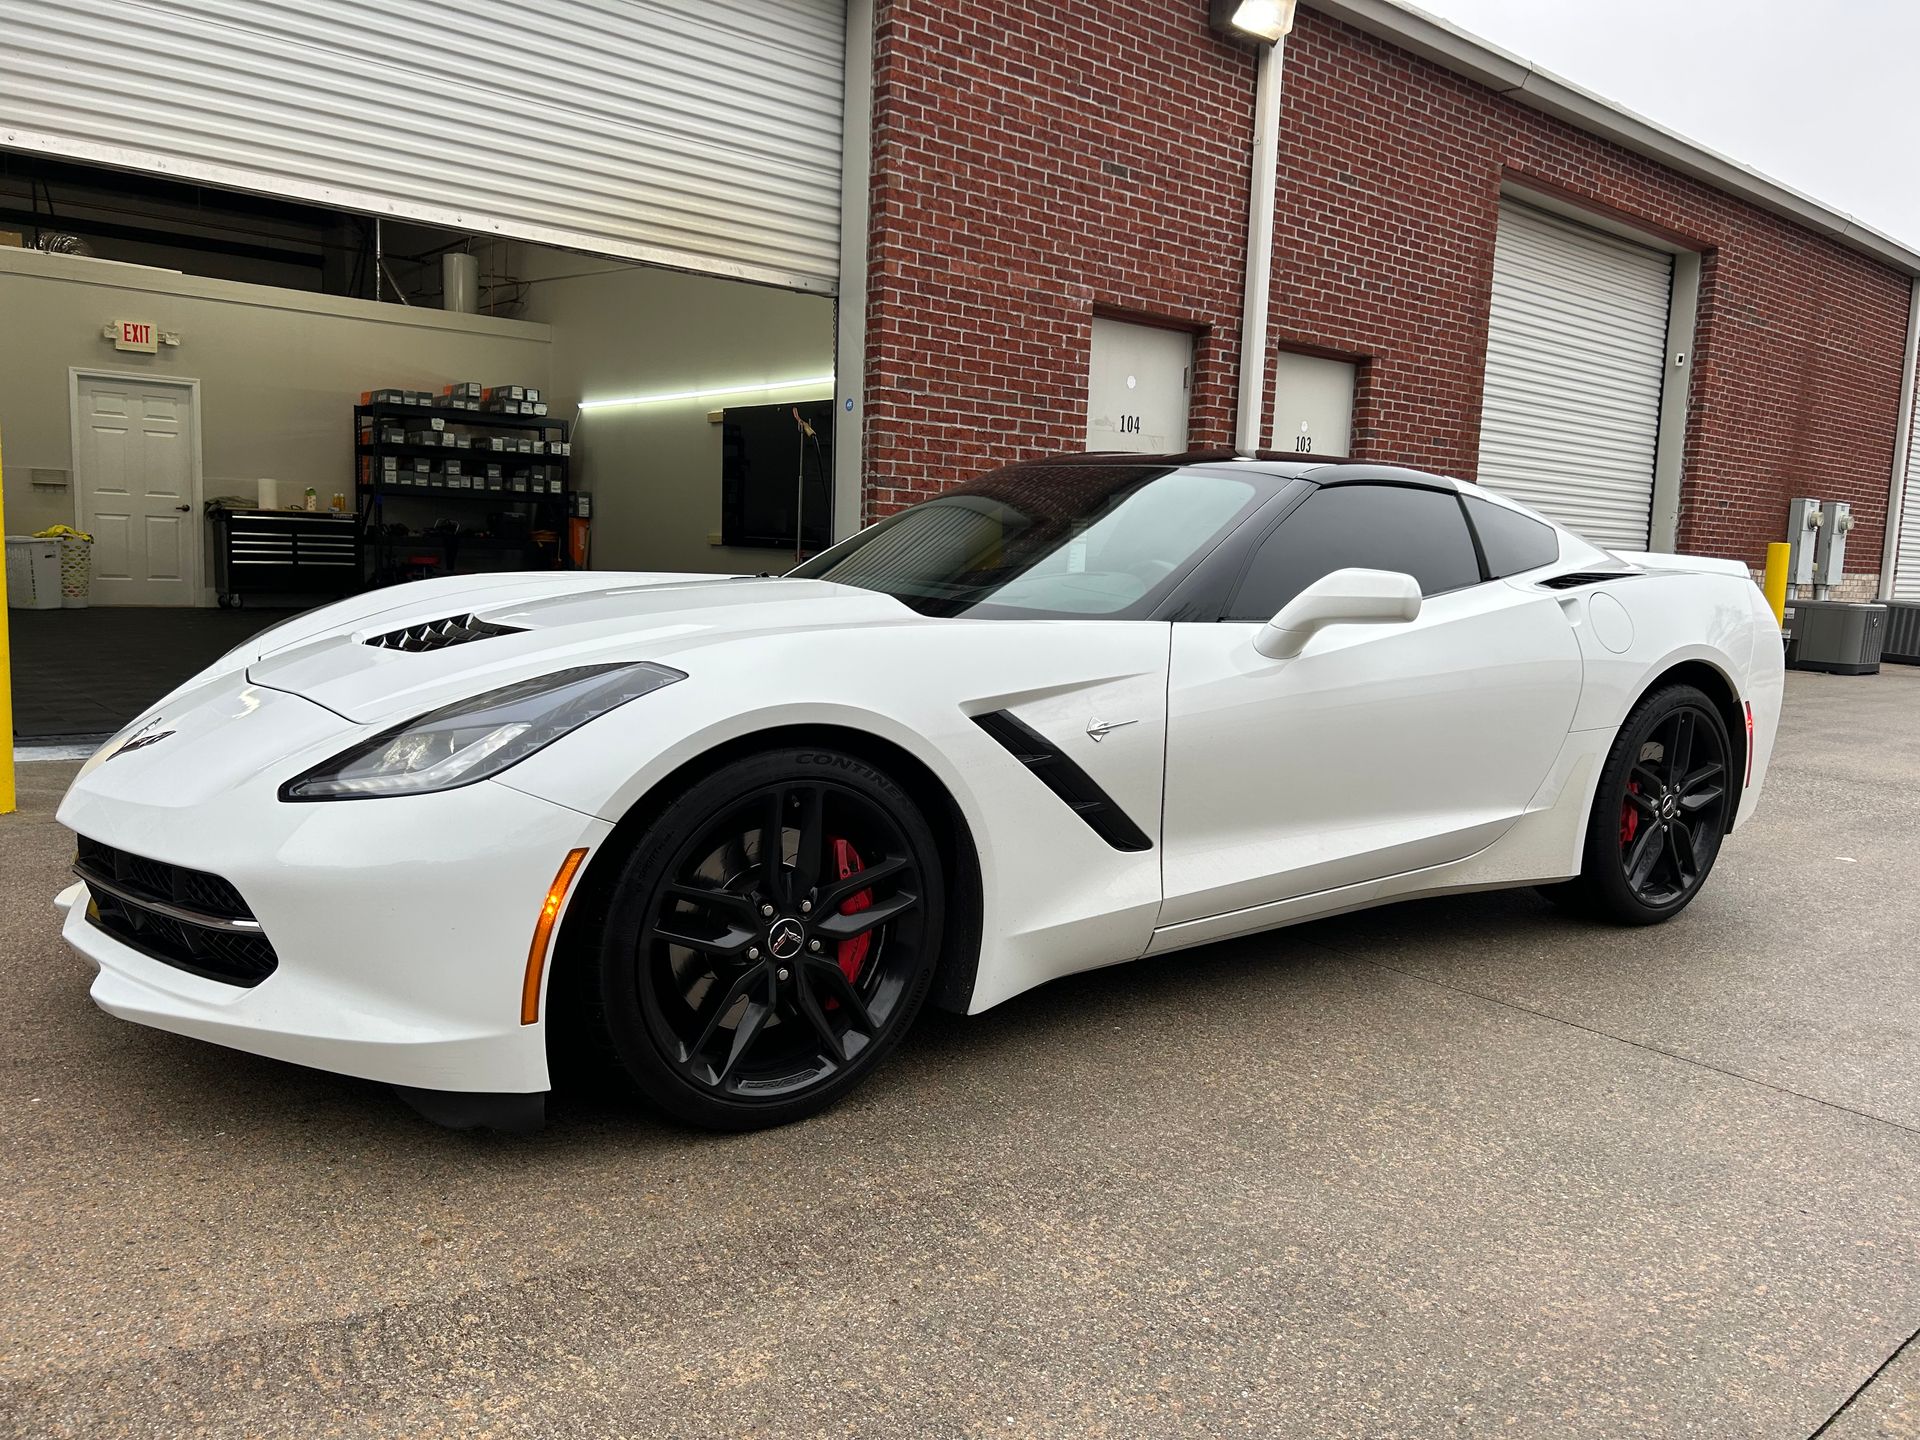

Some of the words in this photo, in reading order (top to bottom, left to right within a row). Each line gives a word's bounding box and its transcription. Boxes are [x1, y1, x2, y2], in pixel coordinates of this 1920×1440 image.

[123, 323, 150, 344] EXIT
[1120, 415, 1140, 434] 104
[1295, 436, 1311, 453] 103
